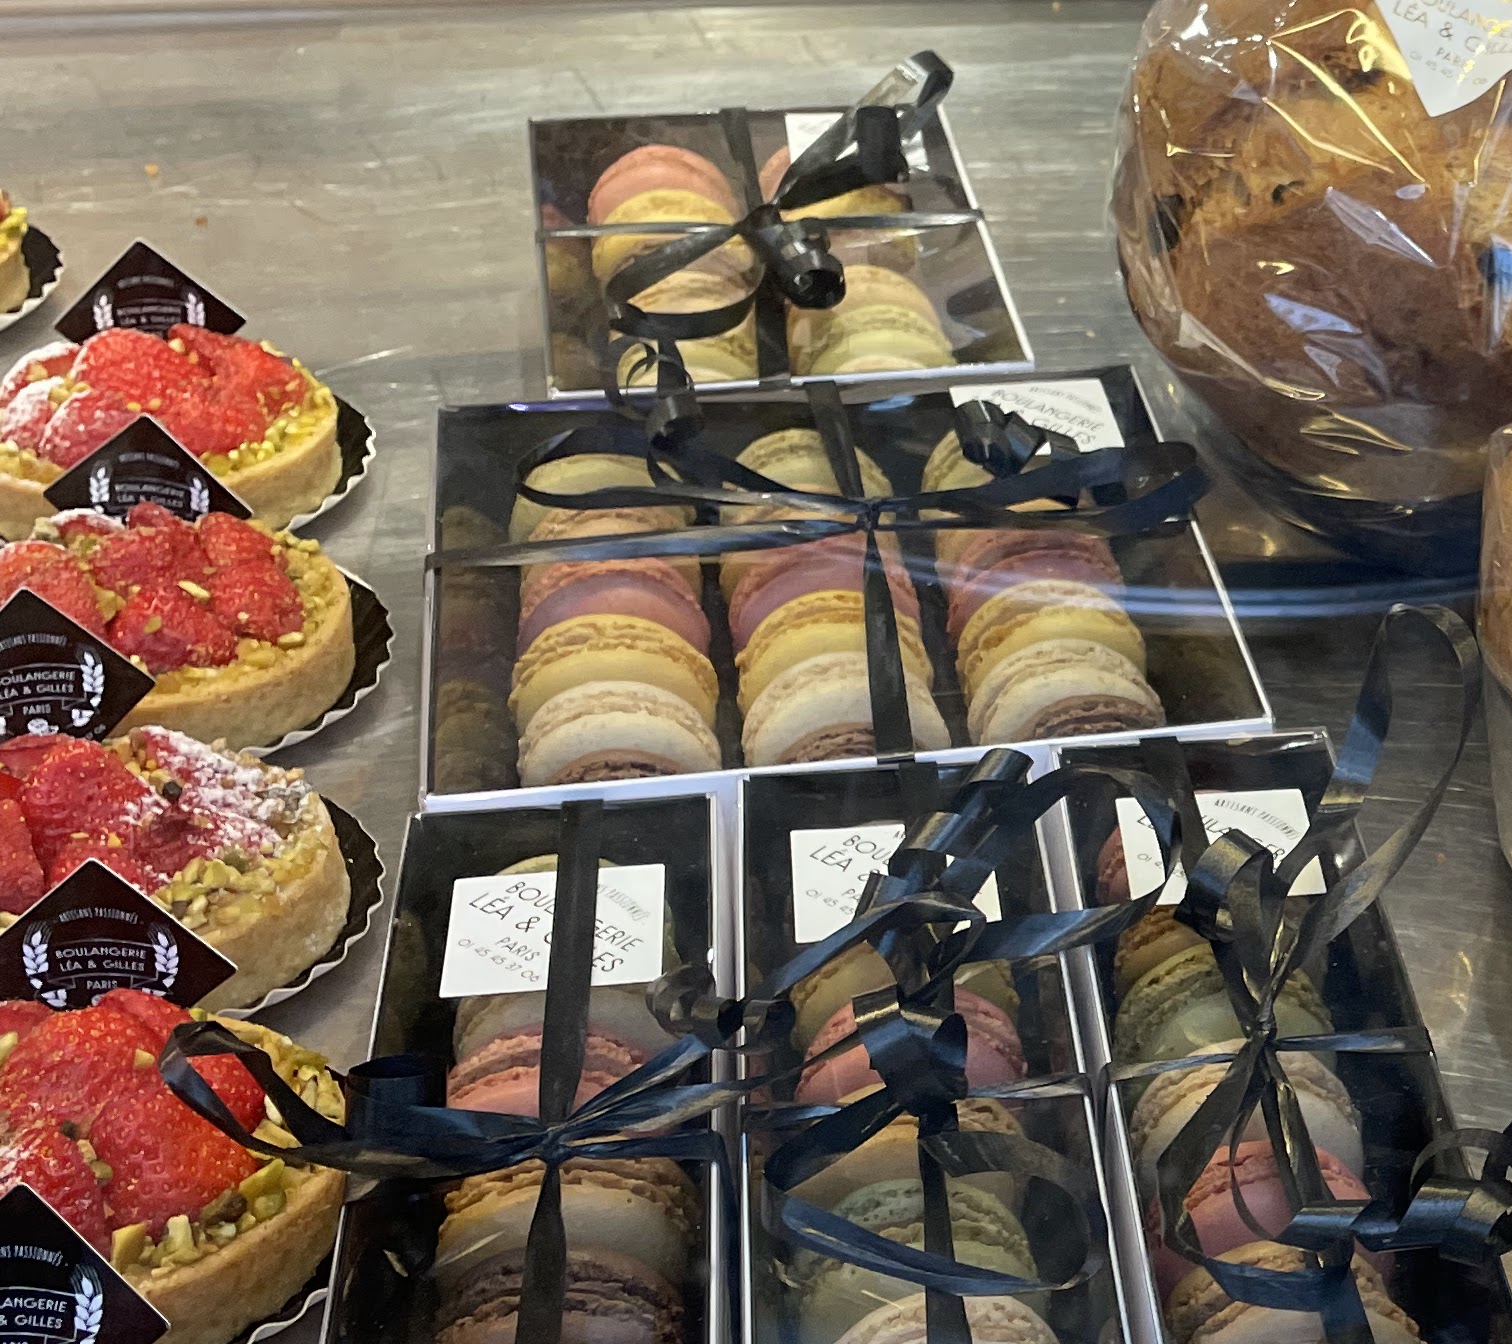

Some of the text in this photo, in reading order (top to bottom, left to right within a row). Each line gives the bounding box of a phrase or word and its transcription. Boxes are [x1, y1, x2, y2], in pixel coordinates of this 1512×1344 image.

[1393, 0, 1429, 29] LÉA
[1438, 21, 1453, 40] &
[0, 670, 76, 686] OULANGERIE
[809, 845, 853, 873] LÉA
[468, 892, 541, 933] LÉA &
[55, 946, 147, 960] BOULANGERIE
[495, 936, 541, 962] PARIS
[59, 959, 145, 973] LÉA & GILLES
[86, 980, 118, 990] PARIS
[0, 1297, 68, 1313] ANGERIE
[14, 1314, 63, 1329] GILLES
